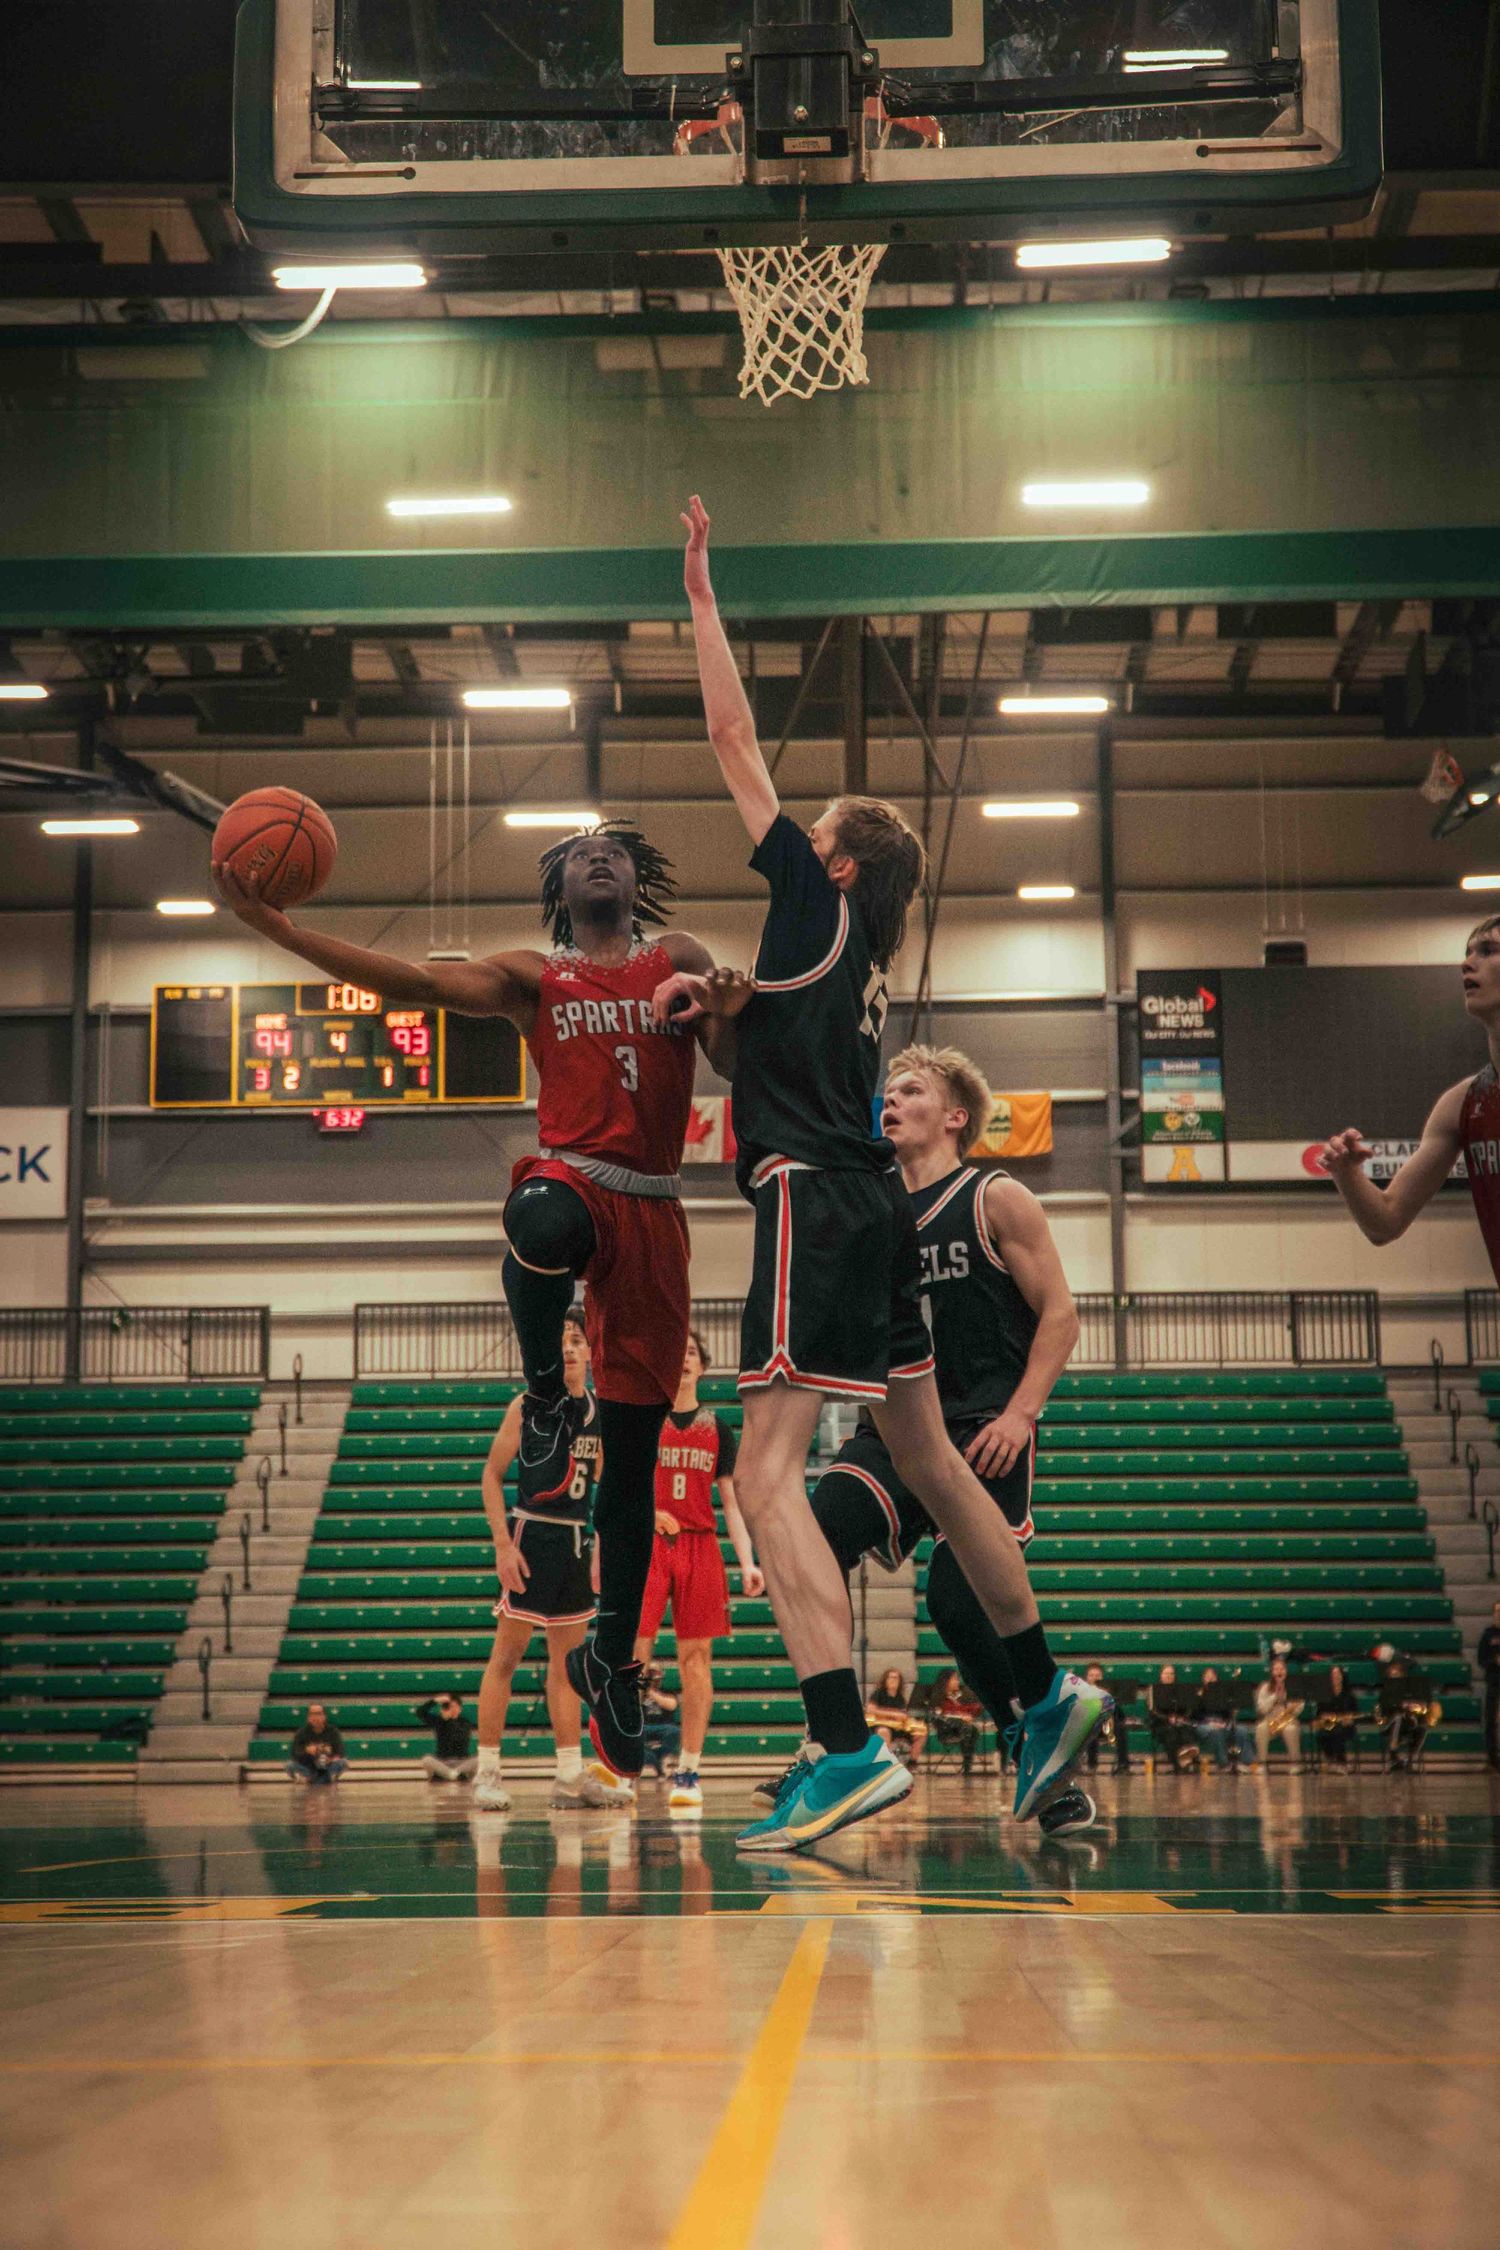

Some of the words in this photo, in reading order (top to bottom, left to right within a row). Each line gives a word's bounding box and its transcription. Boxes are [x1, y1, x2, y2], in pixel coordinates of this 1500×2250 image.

[1141, 996, 1204, 1014] Global
[551, 999, 682, 1041] SPARTA
[1158, 1014, 1204, 1028] NEWS
[255, 1030, 293, 1056] 94
[329, 1031, 347, 1053] 4
[392, 1027, 430, 1056] 93
[255, 1067, 271, 1091] 3
[283, 1066, 300, 1090] 2
[382, 1066, 393, 1088] 1
[419, 1065, 430, 1087] 1
[615, 1045, 639, 1092] 3
[658, 1446, 715, 1473] ARTANS
[569, 1462, 588, 1500] 6
[672, 1473, 687, 1501] 8
